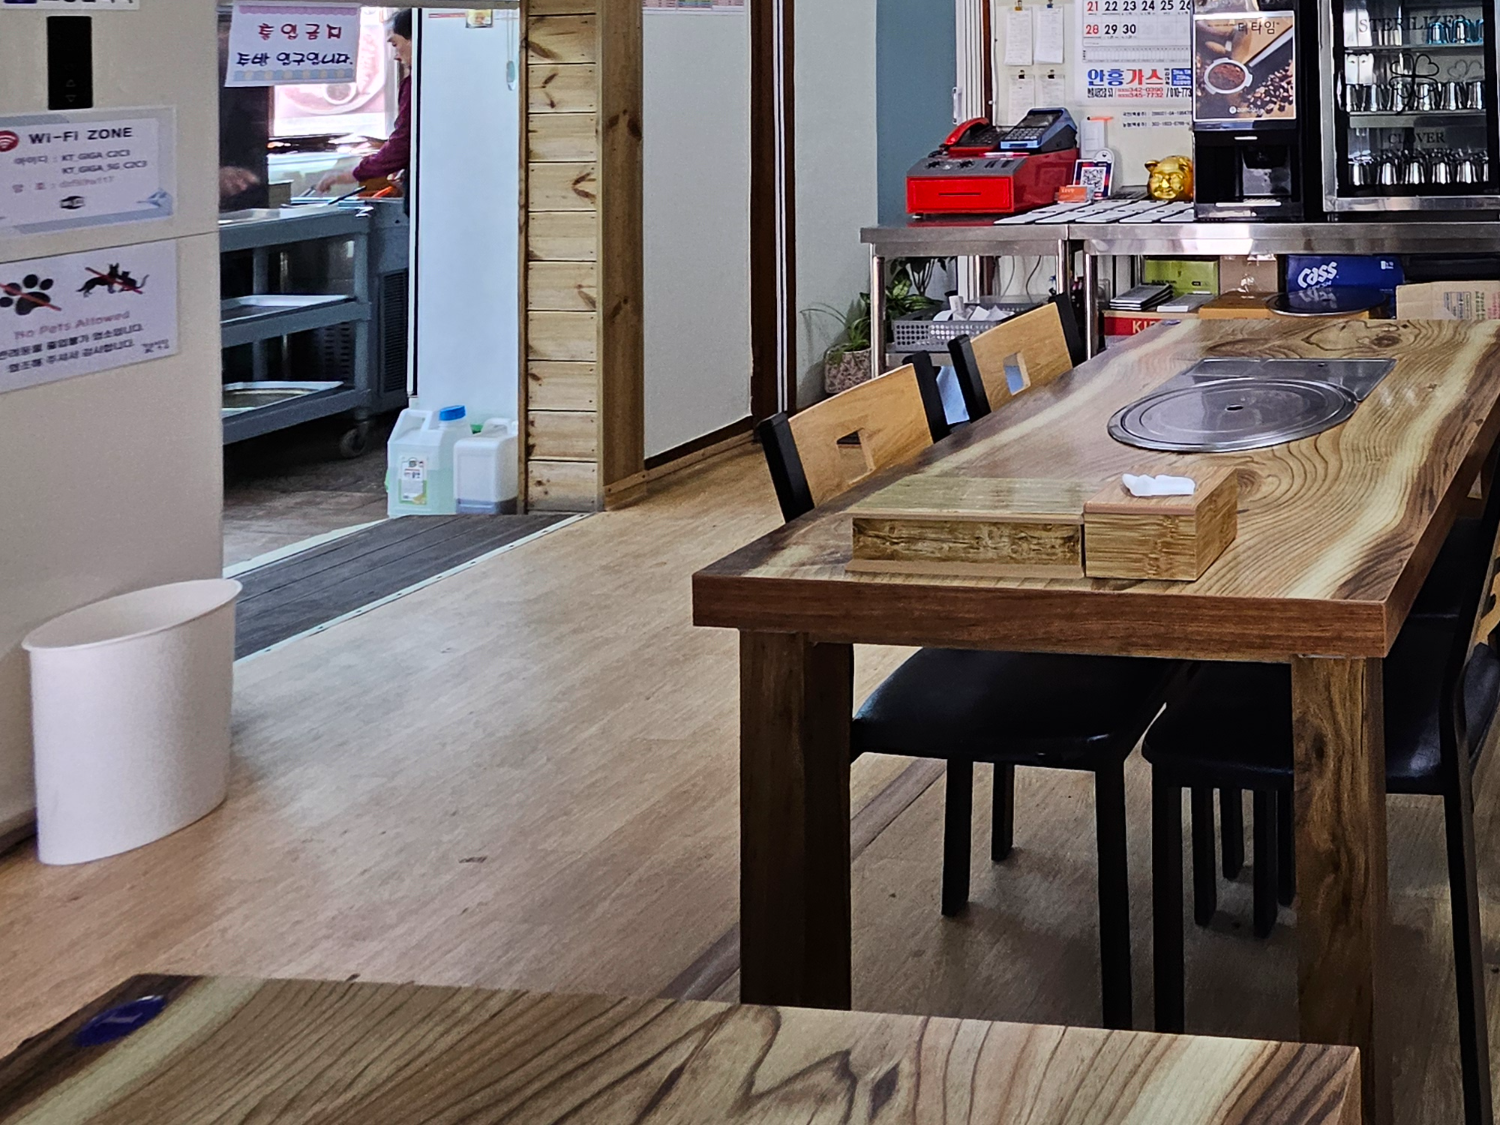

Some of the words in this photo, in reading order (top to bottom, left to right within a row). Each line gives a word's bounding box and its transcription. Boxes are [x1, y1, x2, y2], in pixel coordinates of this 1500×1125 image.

[1087, 1, 1098, 12] 21
[1105, 1, 1118, 11] 22
[1123, 1, 1136, 11] 23
[1141, 0, 1155, 11] 24
[1160, 0, 1174, 10] 25
[1086, 25, 1099, 35] 28
[1104, 24, 1118, 35] 29
[1122, 24, 1136, 34] 30
[276, 52, 353, 66] 입구입니다.
[1087, 68, 1164, 86] 안흥가스
[29, 131, 78, 144] Wi-Fi
[87, 127, 133, 140] ZONE
[1298, 261, 1338, 289] Cass
[39, 322, 70, 335] Pets
[75, 311, 130, 327] Allowed
